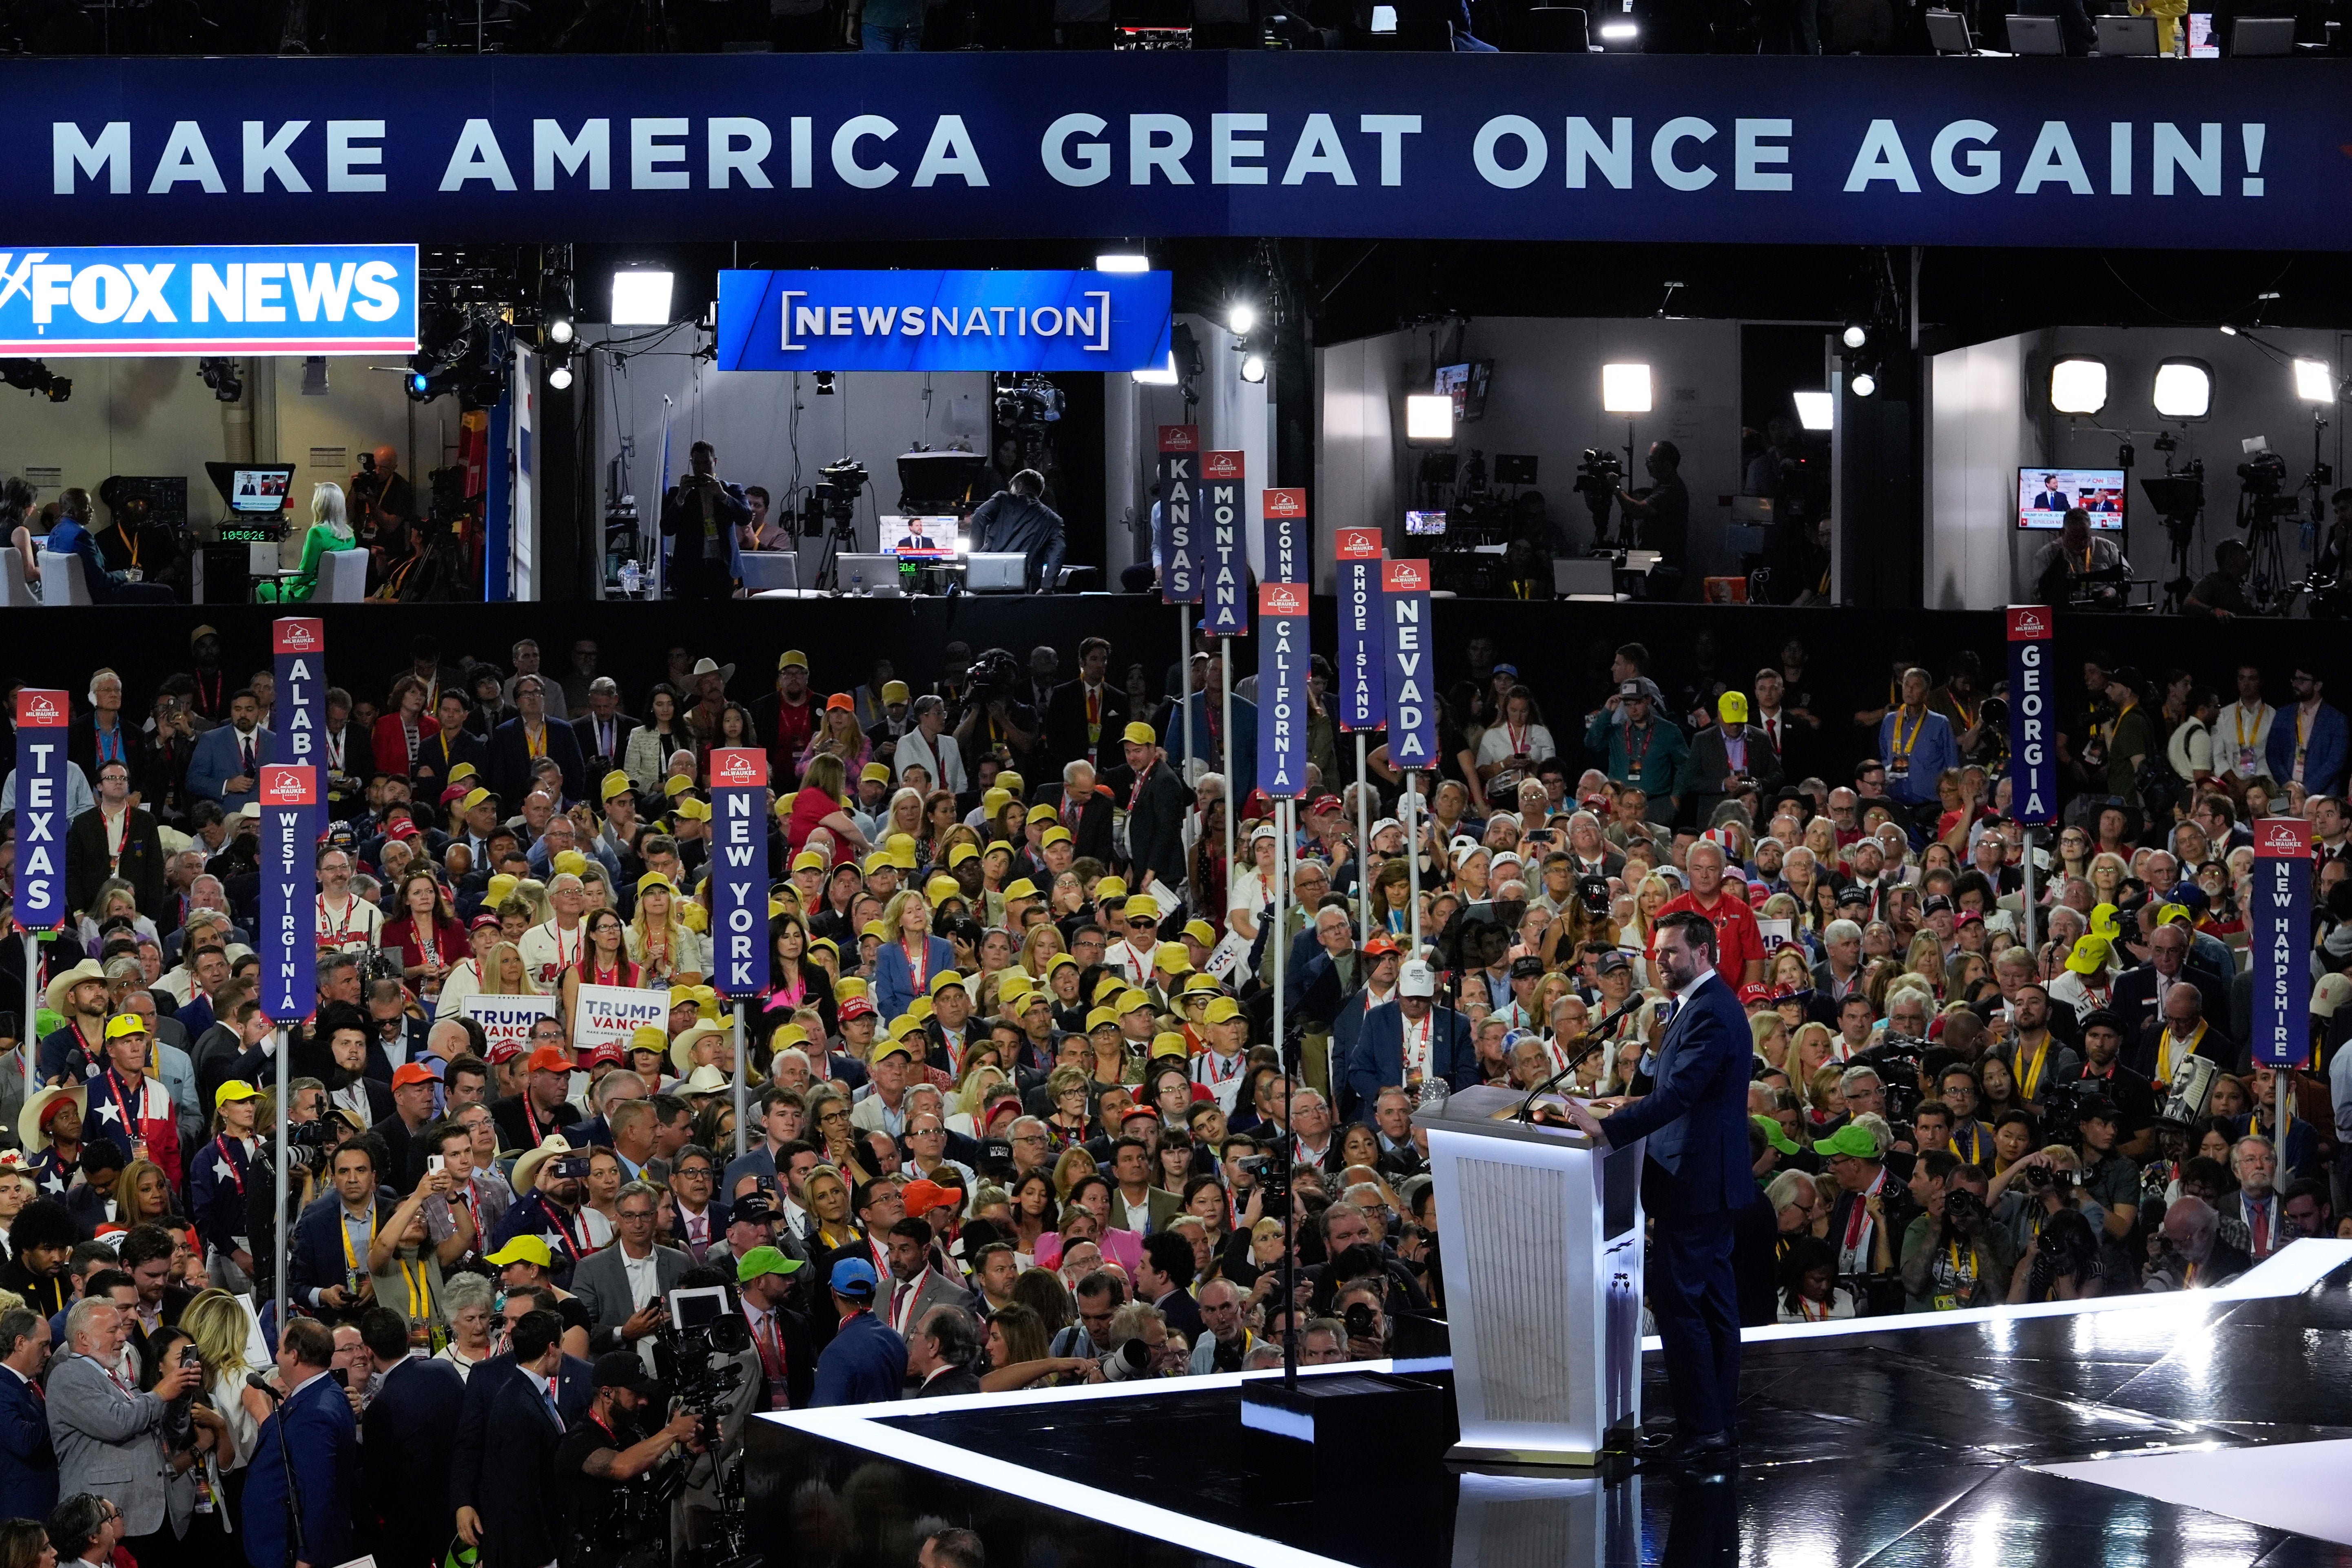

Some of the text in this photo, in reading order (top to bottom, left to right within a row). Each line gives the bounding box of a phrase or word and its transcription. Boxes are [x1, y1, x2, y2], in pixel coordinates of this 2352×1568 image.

[53, 113, 2265, 196] MAKE AMERICA GREAT ONCE AGAIN!
[32, 261, 399, 323] FOX NEWS
[1170, 459, 1192, 592] KANSAS
[1214, 486, 1236, 625] MONTANA
[1274, 621, 1291, 785] CALIFORNIA
[1353, 565, 1369, 719] RHODE ISLAND
[1396, 599, 1424, 756] NEVADA
[2022, 645, 2045, 815] GEORGIA
[24, 744, 54, 909] TEXAS
[725, 794, 755, 985] NEW YORK
[279, 813, 298, 1009] WEST VIRGINIA
[1206, 945, 1233, 972] TRU
[2272, 862, 2292, 1056] NEW HAMPSHIRE
[494, 1041, 506, 1050] MAKE
[498, 1046, 512, 1055] GREAT
[586, 1000, 661, 1019] TRUMP
[595, 1050, 620, 1058] AMERICA
[848, 1004, 861, 1012] GREAT
[1747, 984, 1767, 994] USA
